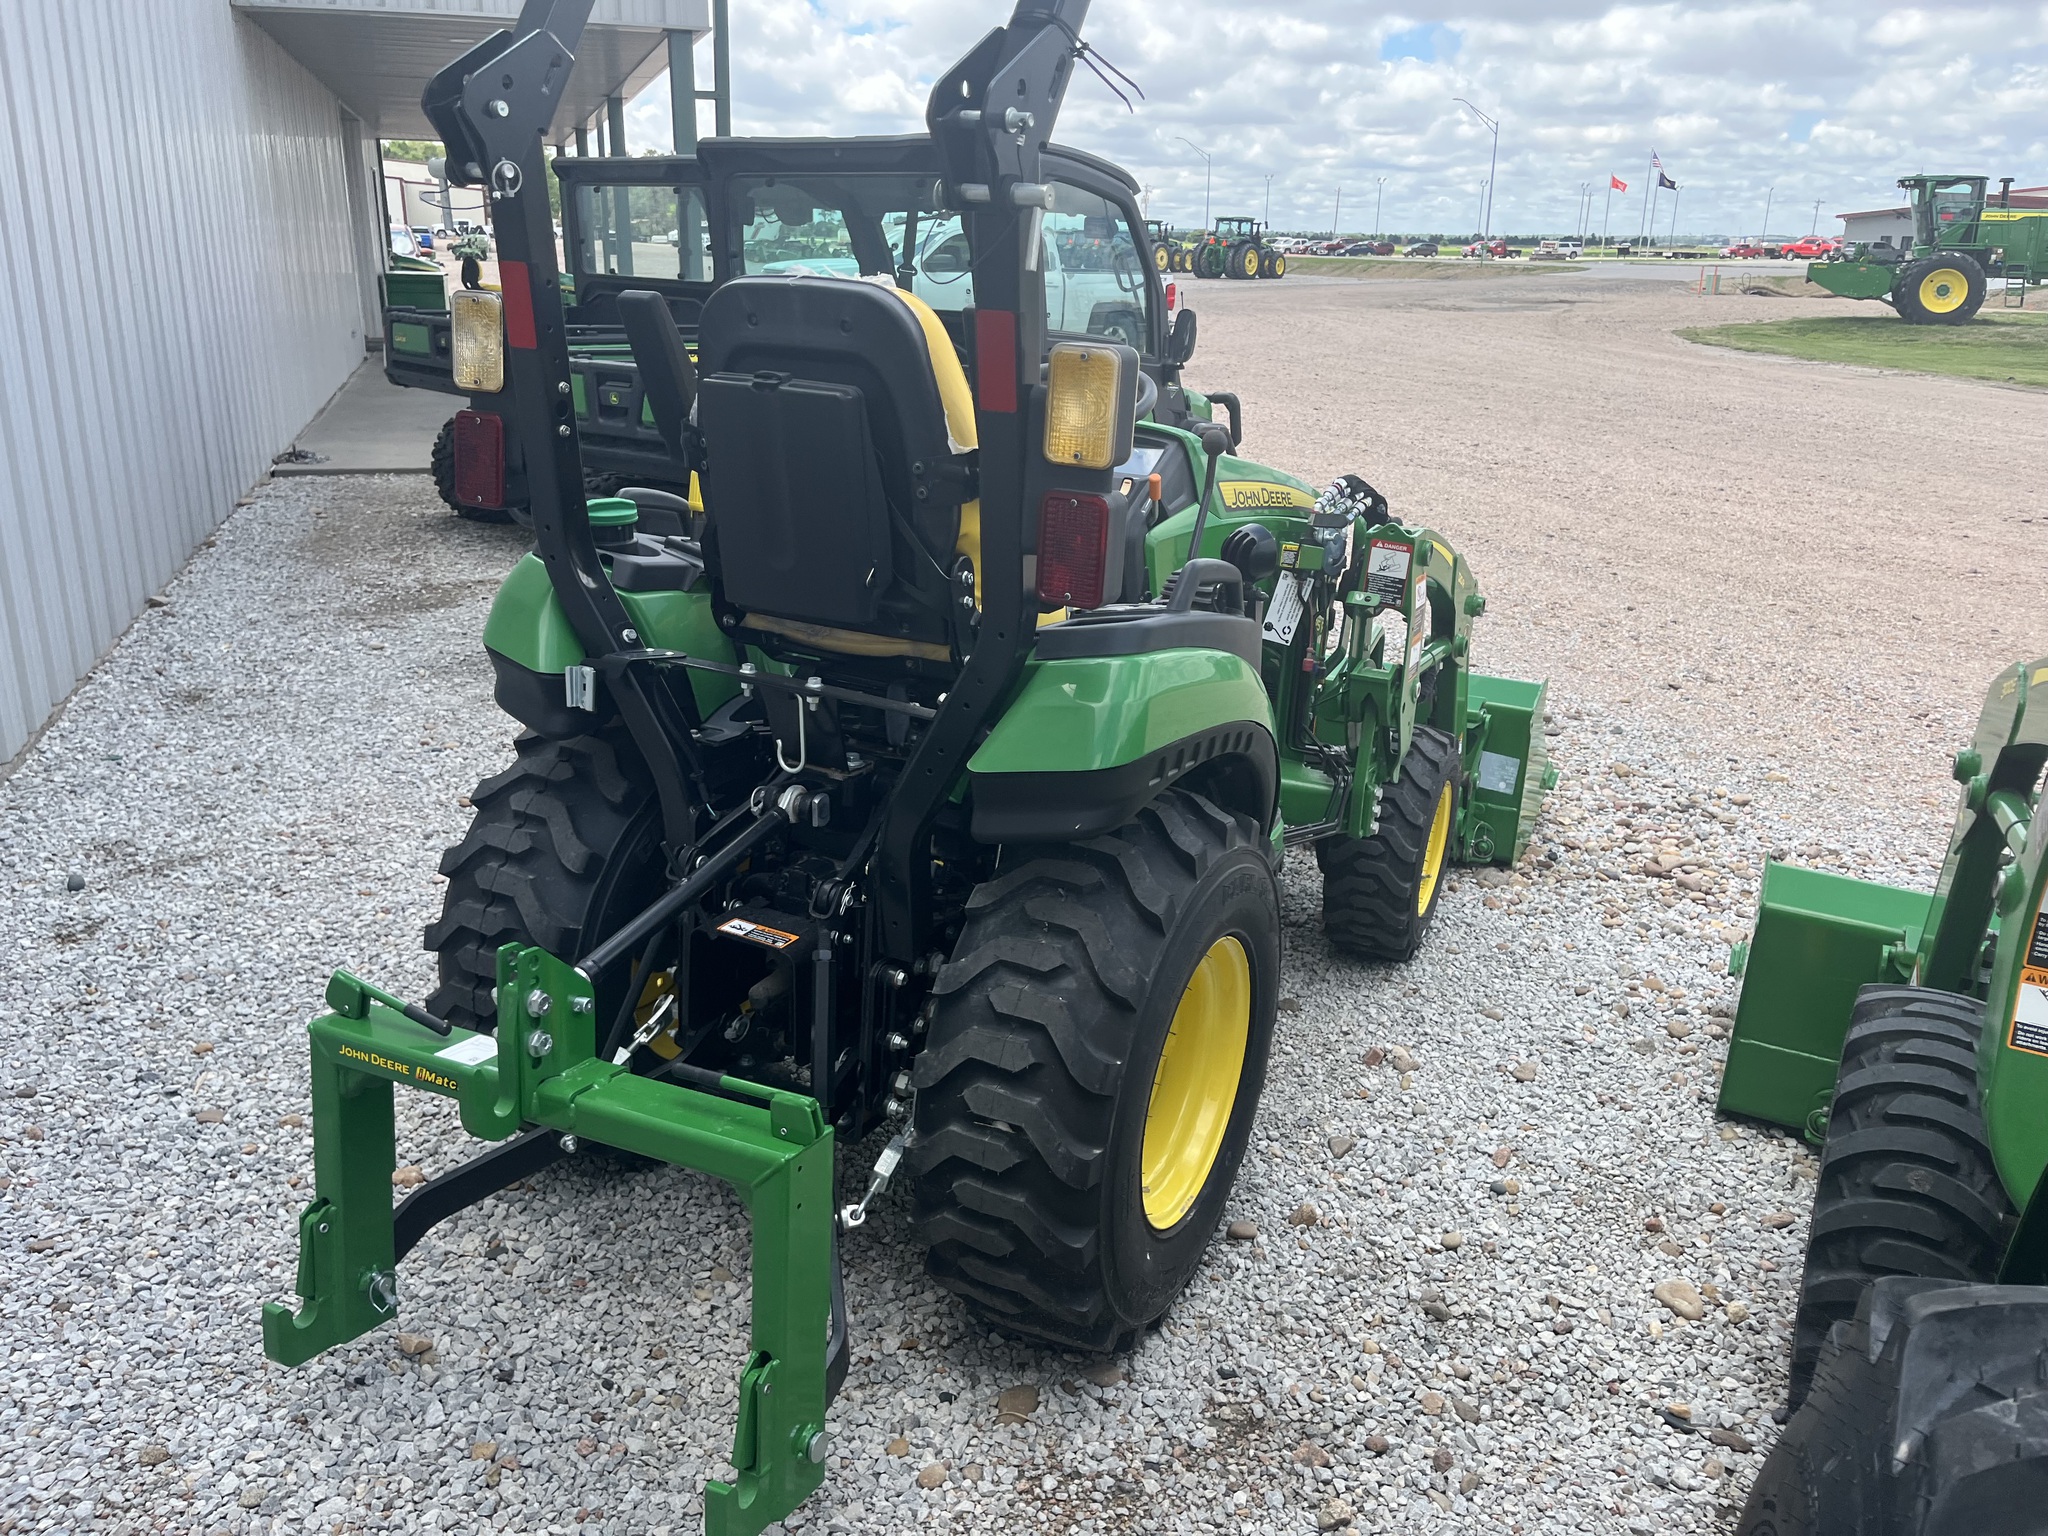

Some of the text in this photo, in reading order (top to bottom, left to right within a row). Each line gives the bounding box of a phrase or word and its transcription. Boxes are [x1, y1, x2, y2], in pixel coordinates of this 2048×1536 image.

[1232, 488, 1293, 506] JOHN DEERE
[1383, 542, 1408, 552] DANGER
[339, 1044, 369, 1062] JOHN
[371, 1053, 410, 1075] DEERE
